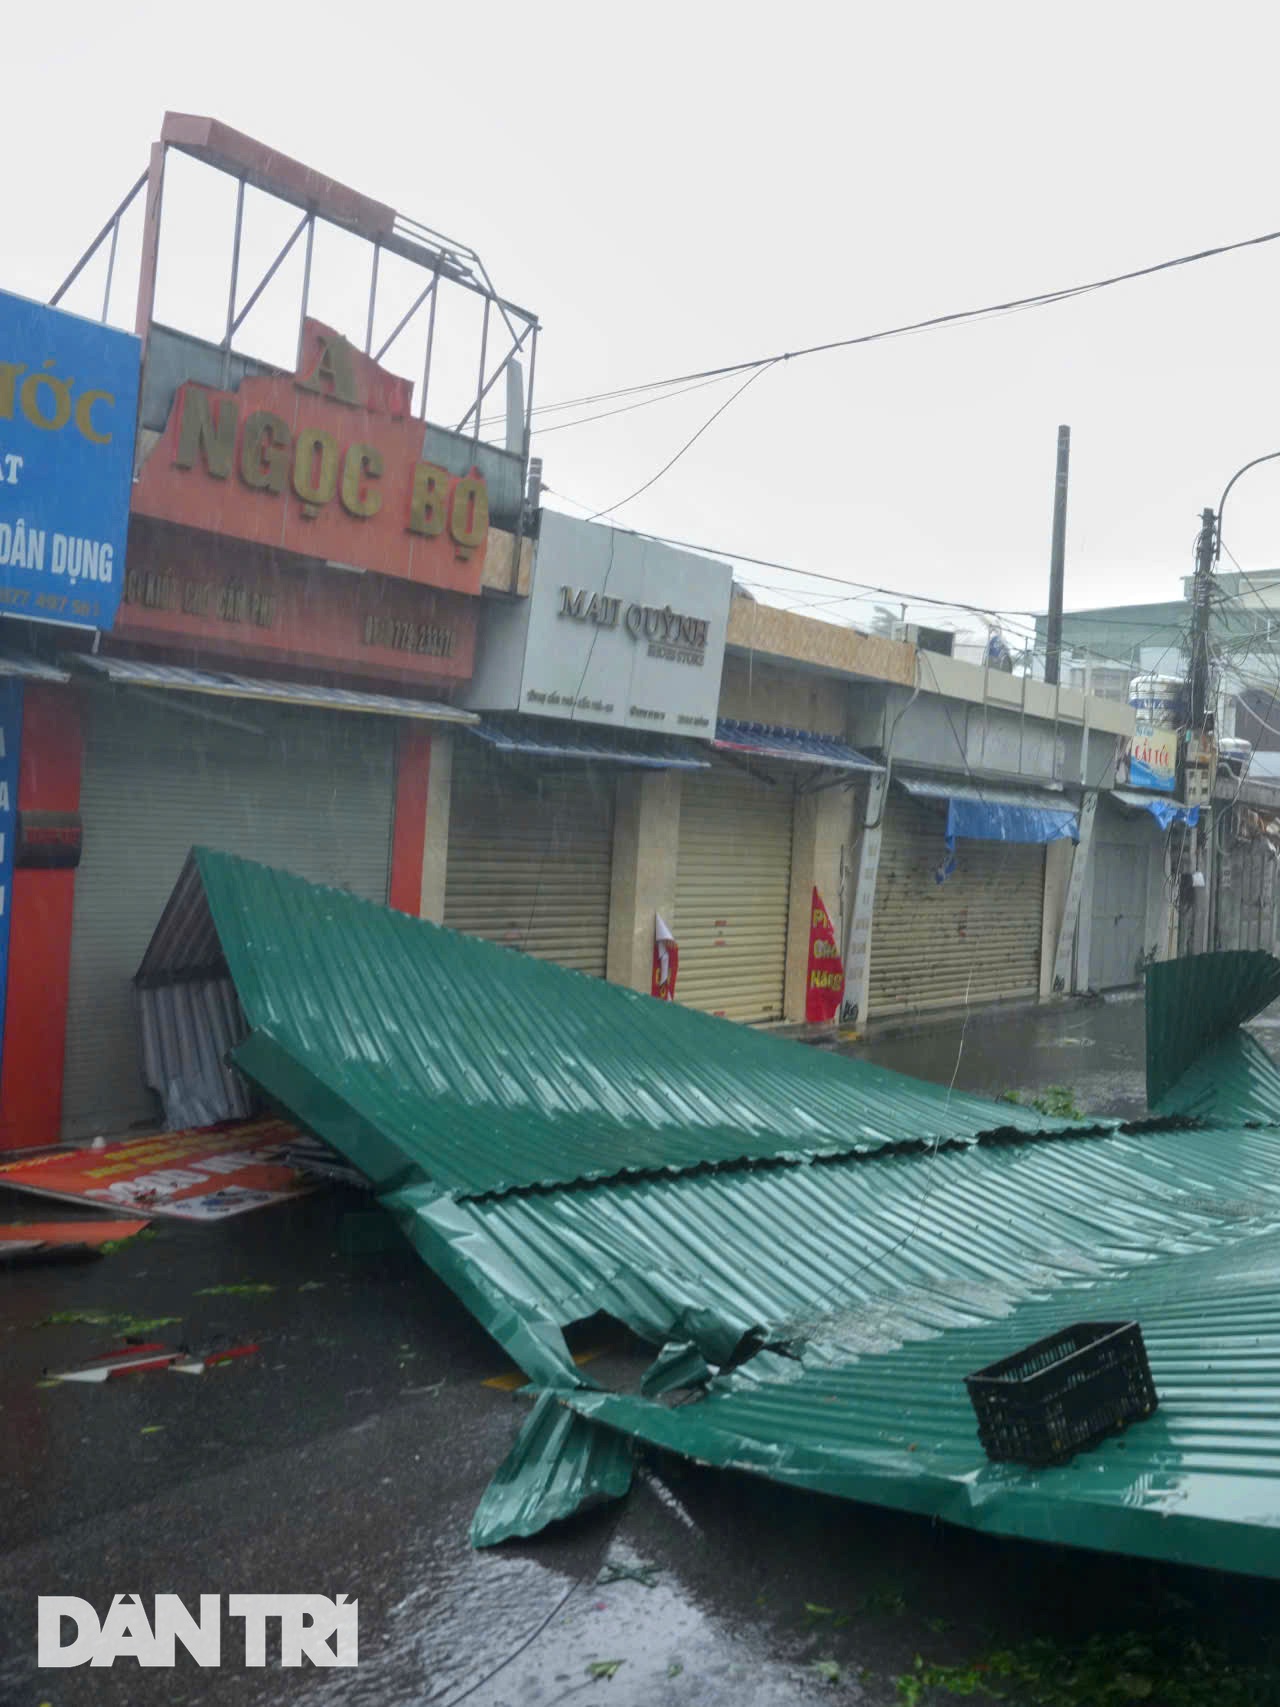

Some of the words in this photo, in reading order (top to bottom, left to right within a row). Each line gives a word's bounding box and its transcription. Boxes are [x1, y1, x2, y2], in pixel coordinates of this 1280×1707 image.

[174, 388, 384, 519] NGỌC
[0, 518, 45, 571] DÂN
[51, 533, 113, 585] DỤNG
